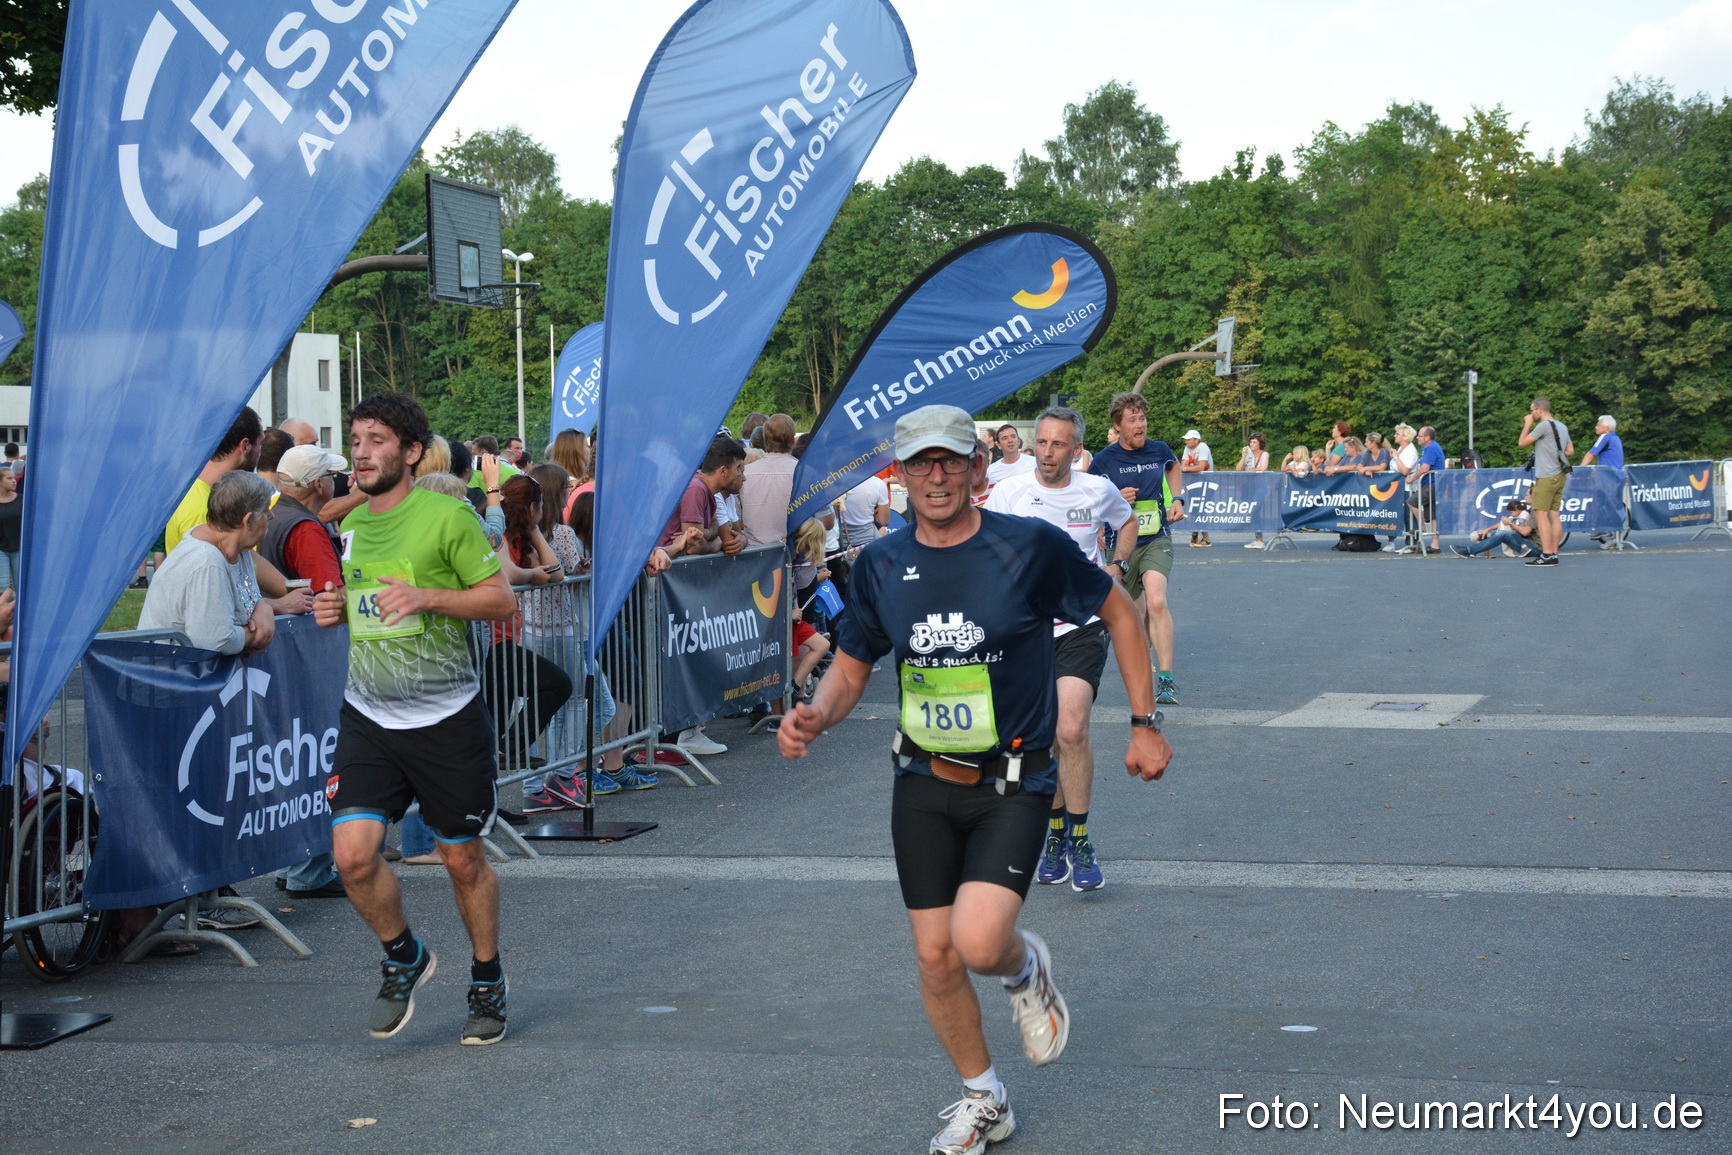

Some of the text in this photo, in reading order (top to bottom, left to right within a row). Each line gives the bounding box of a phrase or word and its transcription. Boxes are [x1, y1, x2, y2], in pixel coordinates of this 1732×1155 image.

[684, 22, 848, 281] Fischer
[744, 72, 868, 278] AUTOMOBILE
[966, 301, 1098, 381] Druck und Medien
[843, 314, 1033, 431] Frischmann
[1188, 497, 1258, 514] Fischer
[1288, 490, 1370, 508] Frischmann
[1630, 483, 1693, 503] Frischmann
[1194, 515, 1252, 524] AUTOMOBILE
[1334, 508, 1398, 519] Druck und Medien
[668, 606, 760, 658] Frischmann
[910, 621, 985, 654] Burgis
[725, 647, 747, 672] Druck
[746, 643, 762, 666] und
[920, 701, 973, 731] 180
